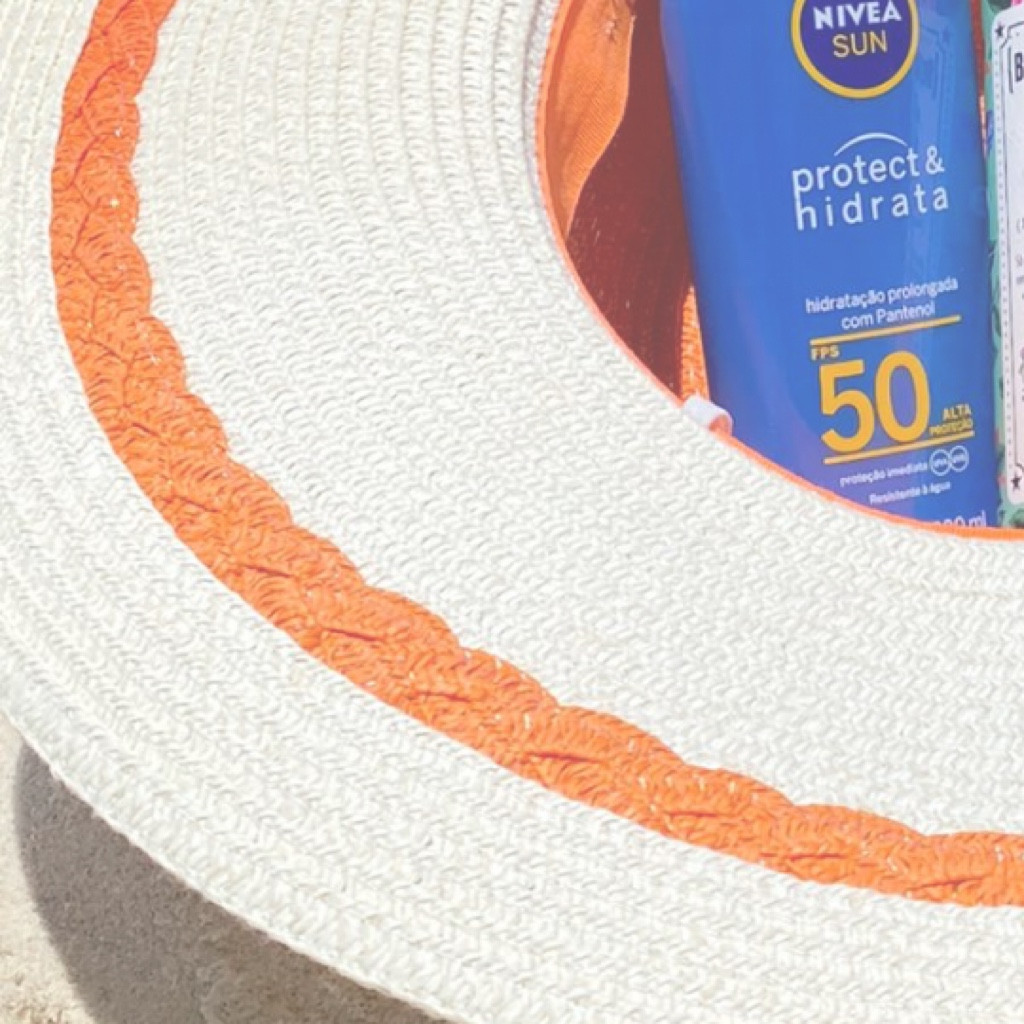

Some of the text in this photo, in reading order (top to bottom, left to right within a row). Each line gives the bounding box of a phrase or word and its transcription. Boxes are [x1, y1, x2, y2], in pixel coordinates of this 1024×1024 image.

[813, 0, 902, 30] NIVEA
[832, 30, 888, 58] SUN
[792, 145, 945, 198] protect &
[795, 183, 949, 232] hidrata
[805, 276, 959, 314] hidratação prolongada
[841, 299, 936, 330] com Pantenol
[811, 345, 840, 361] FPS
[819, 350, 931, 453] 50
[943, 403, 973, 420] ALTA
